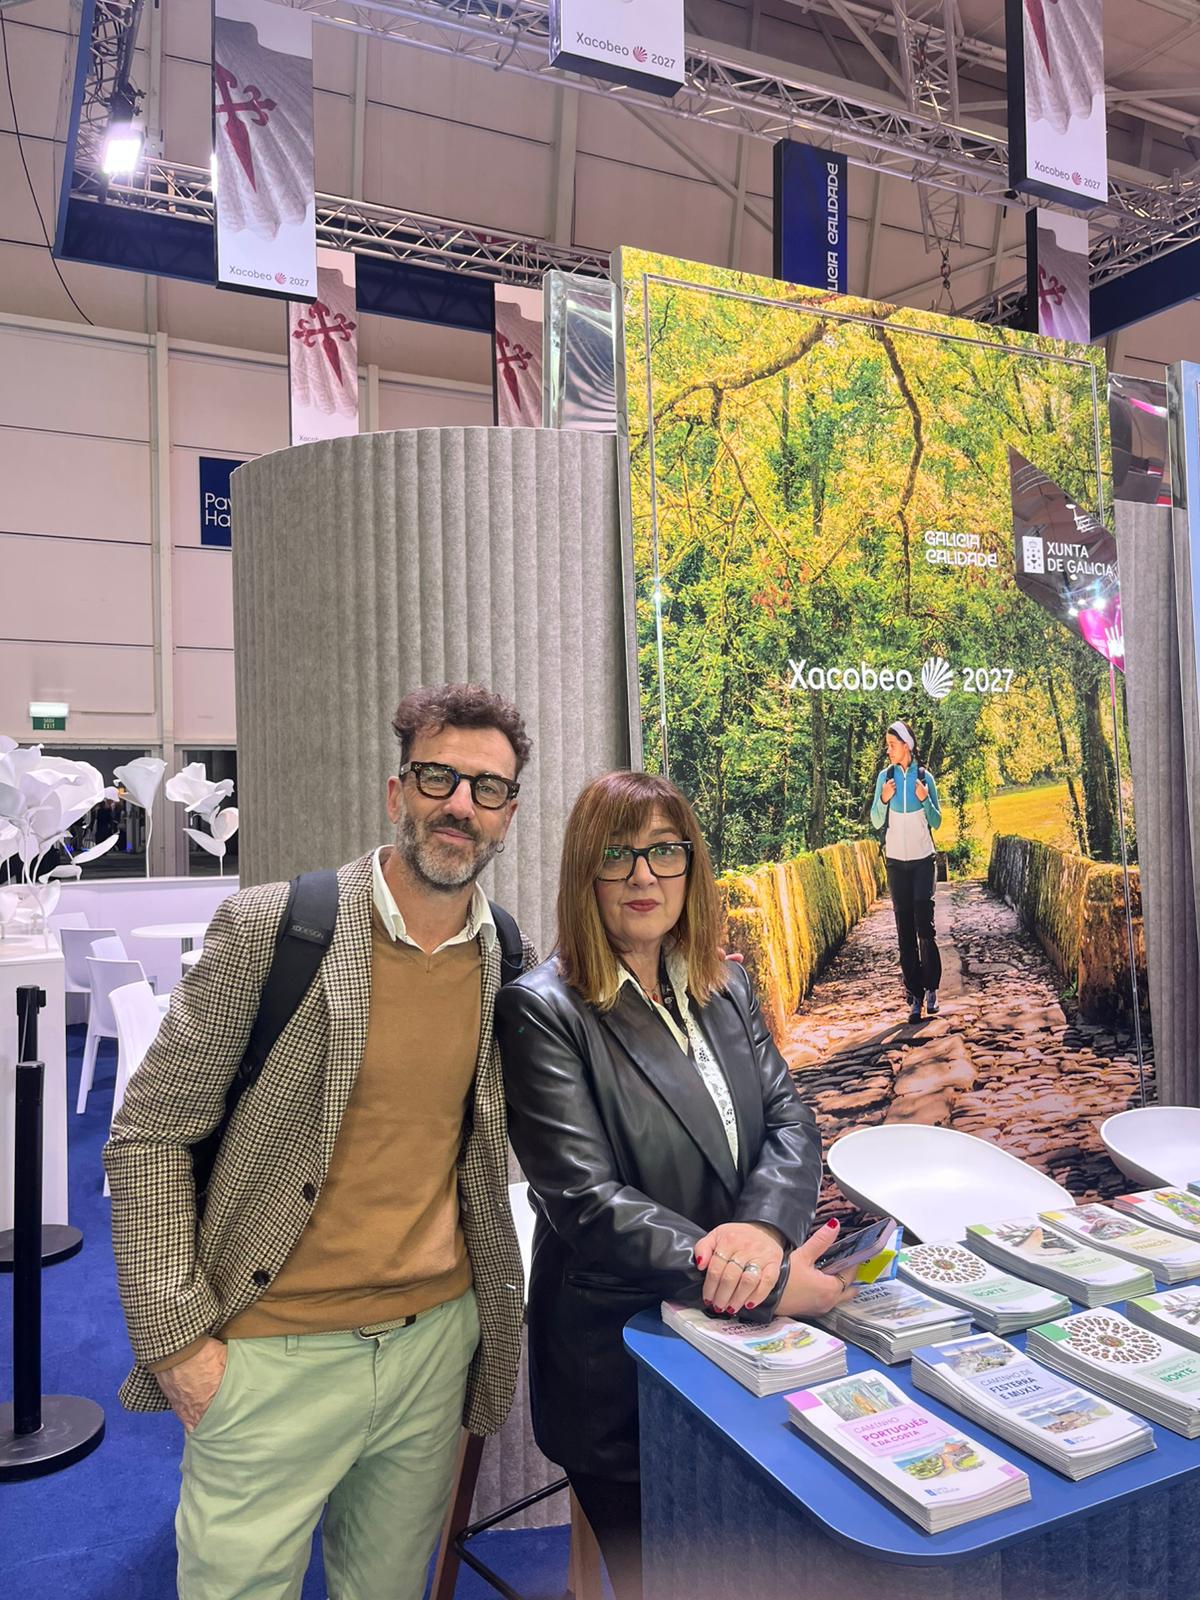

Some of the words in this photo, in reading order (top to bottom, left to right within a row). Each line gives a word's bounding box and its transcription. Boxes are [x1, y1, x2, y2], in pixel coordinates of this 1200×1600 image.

[576, 32, 629, 56] Xacobeo
[651, 54, 676, 69] 2027
[1034, 160, 1070, 181] Xacobeo
[1083, 177, 1101, 190] 2027
[827, 162, 839, 245] CALIDADE
[229, 264, 272, 281] Xacobeo
[289, 276, 310, 287] 2027
[924, 530, 981, 549] GALICIA
[925, 549, 999, 568] CALIDADE
[1046, 541, 1089, 559] XUNTA
[1047, 558, 1064, 573] DE
[1066, 560, 1114, 577] GALICIA
[788, 658, 913, 692] Xacobeo
[961, 667, 1014, 693] 2027
[1160, 1367, 1197, 1383] NORTE
[989, 1376, 1038, 1394] FISTERRA
[1000, 1392, 1008, 1400] E
[862, 1417, 929, 1442] PORTUGUÊS
[878, 1438, 892, 1447] DA
[891, 1430, 921, 1444] COSTA
